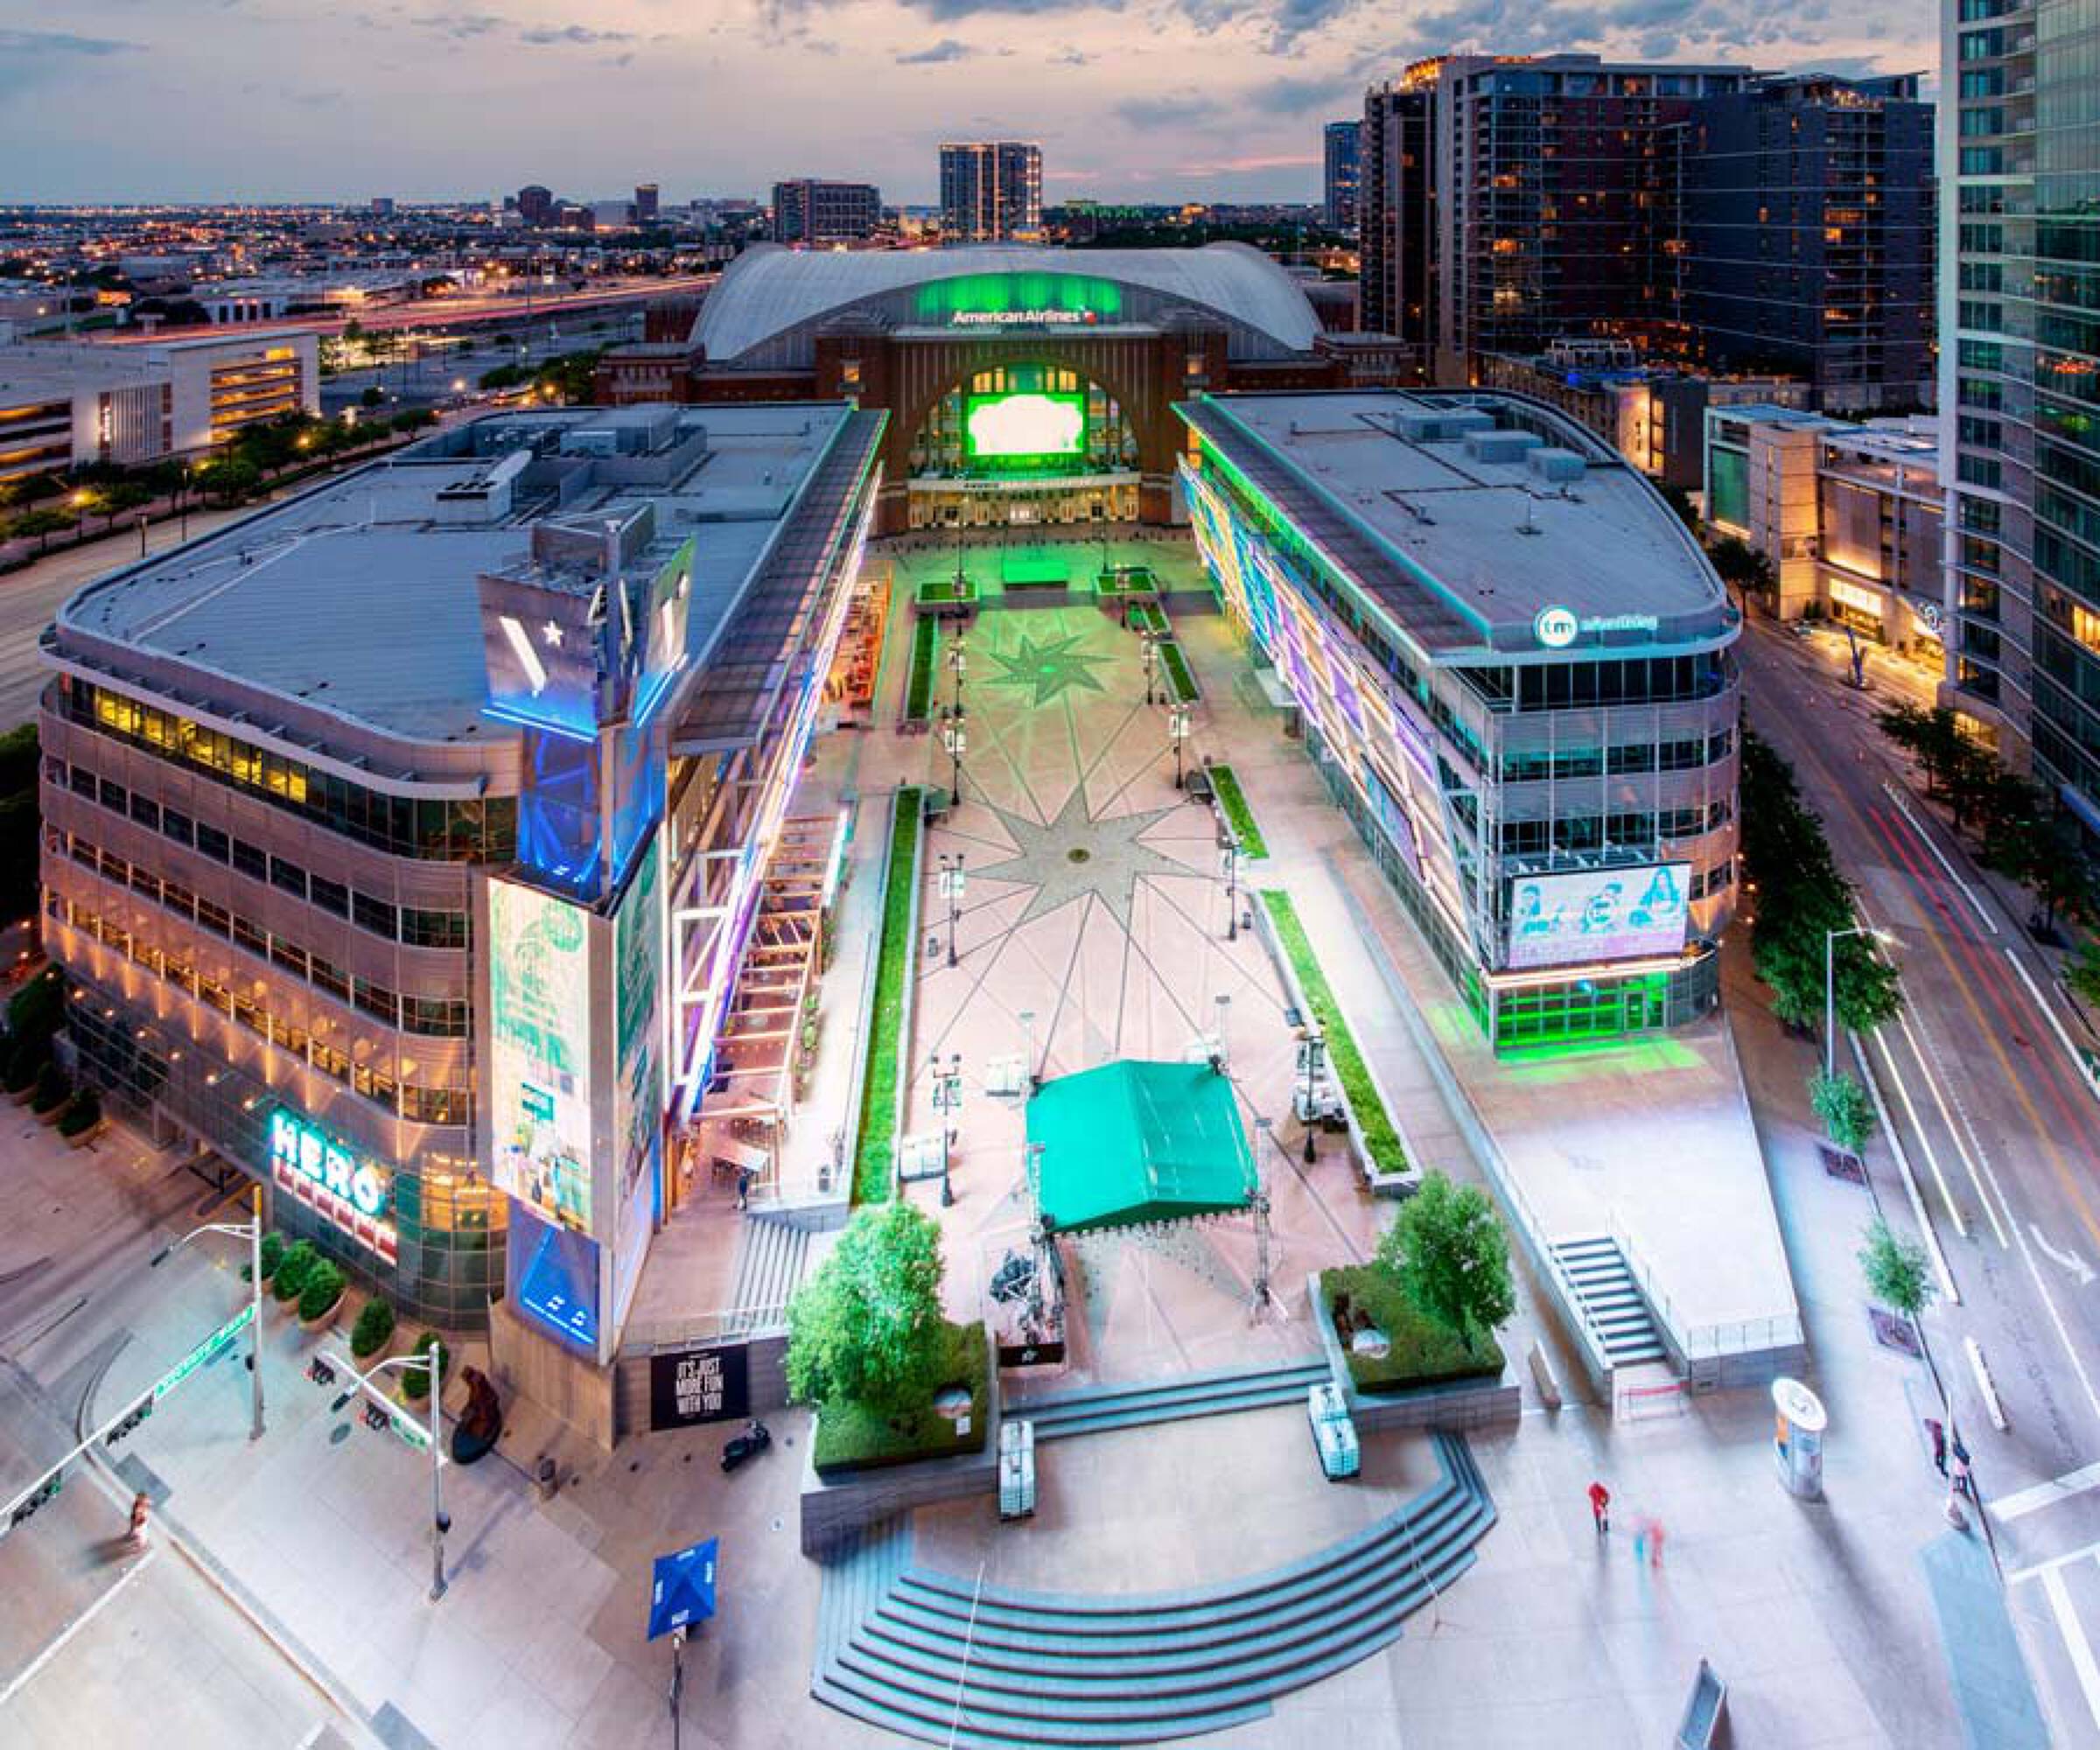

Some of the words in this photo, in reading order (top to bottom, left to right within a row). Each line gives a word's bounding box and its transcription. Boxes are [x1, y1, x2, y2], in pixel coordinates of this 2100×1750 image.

[953, 309, 1023, 323] American
[1026, 309, 1081, 323] Airlines
[272, 1113, 382, 1214] HERO
[678, 1362, 698, 1380] IT'S
[697, 1357, 719, 1377] JUST
[676, 1377, 702, 1396] MORE
[704, 1374, 724, 1393] FUN
[677, 1395, 701, 1415] WITH
[702, 1392, 722, 1410] YOU
